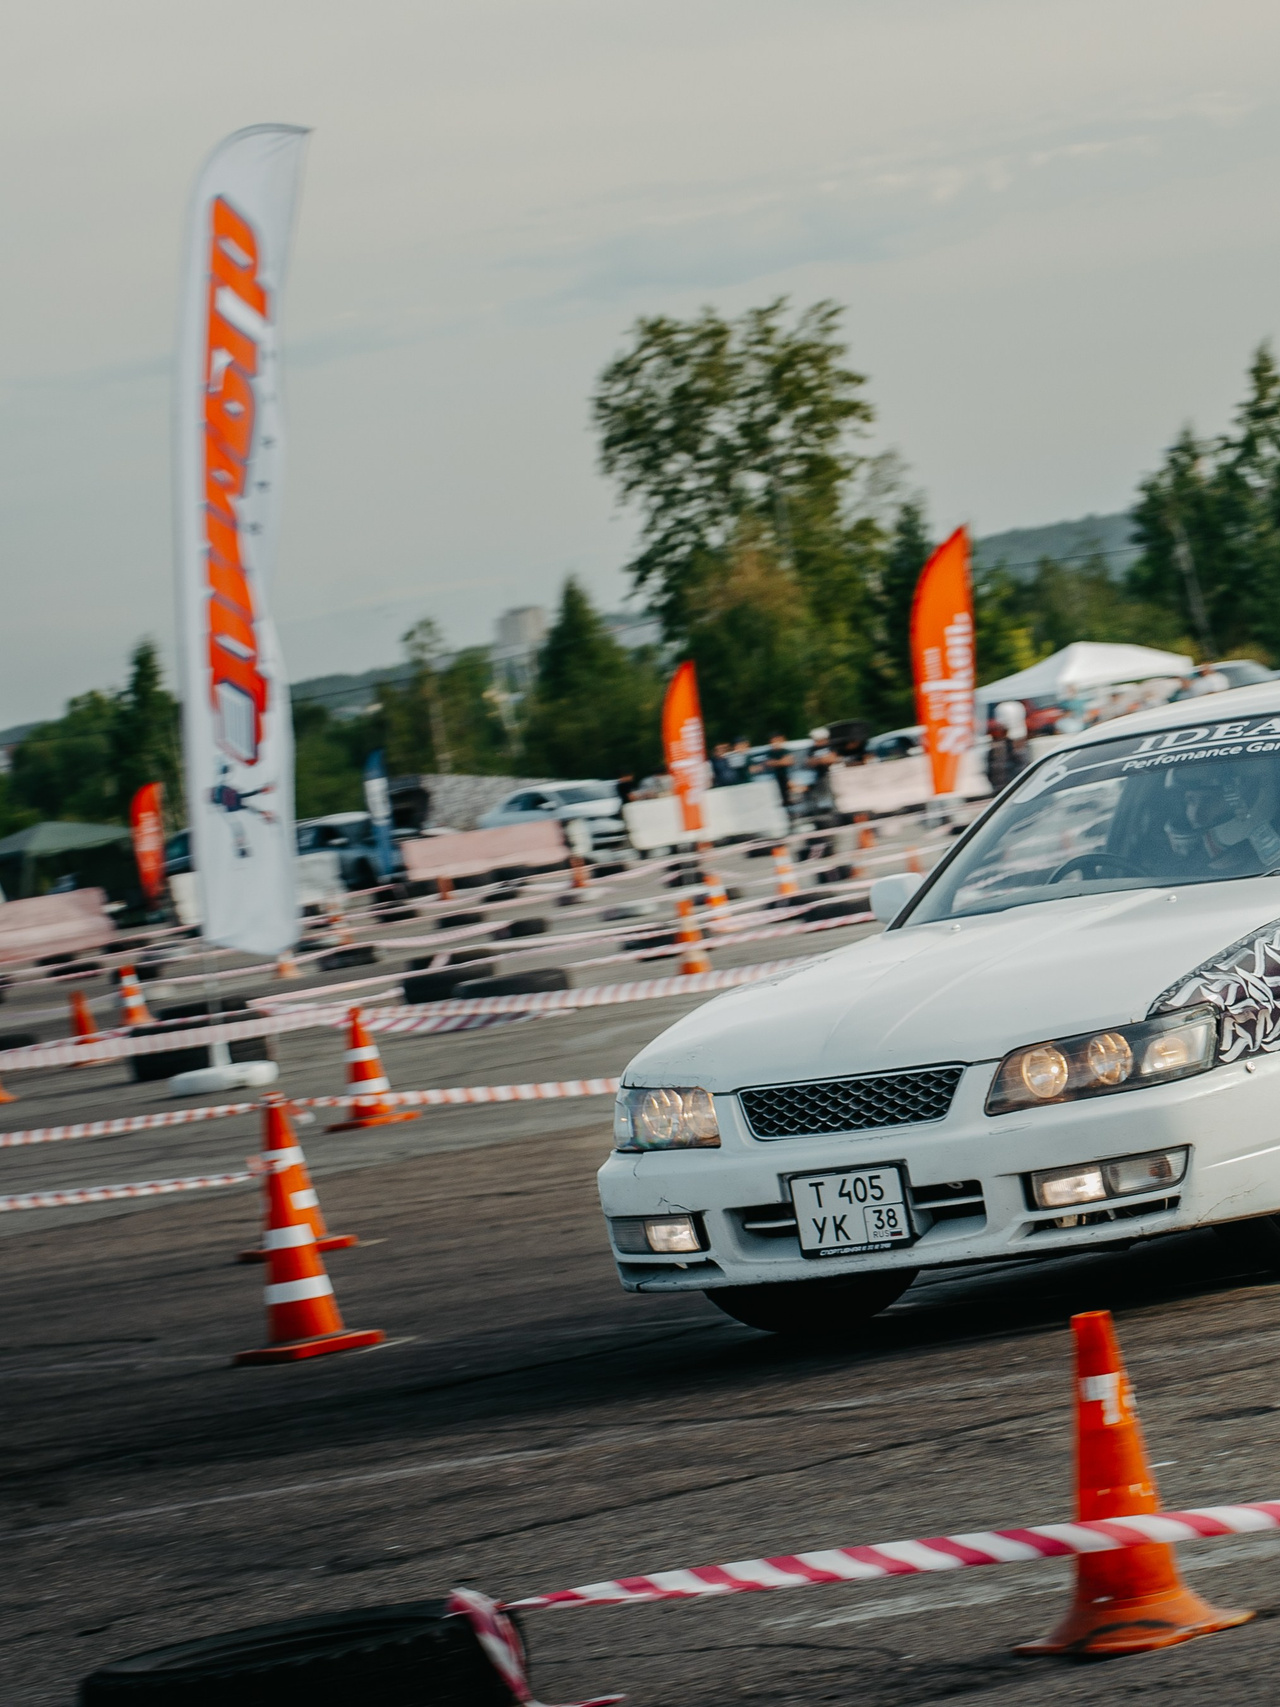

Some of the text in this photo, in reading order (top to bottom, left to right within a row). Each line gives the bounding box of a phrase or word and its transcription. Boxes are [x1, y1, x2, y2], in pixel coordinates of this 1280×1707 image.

[1121, 744, 1241, 772] Perfomance
[838, 1174, 885, 1205] 405
[872, 1208, 899, 1230] 38
[873, 1229, 890, 1239] RUS
